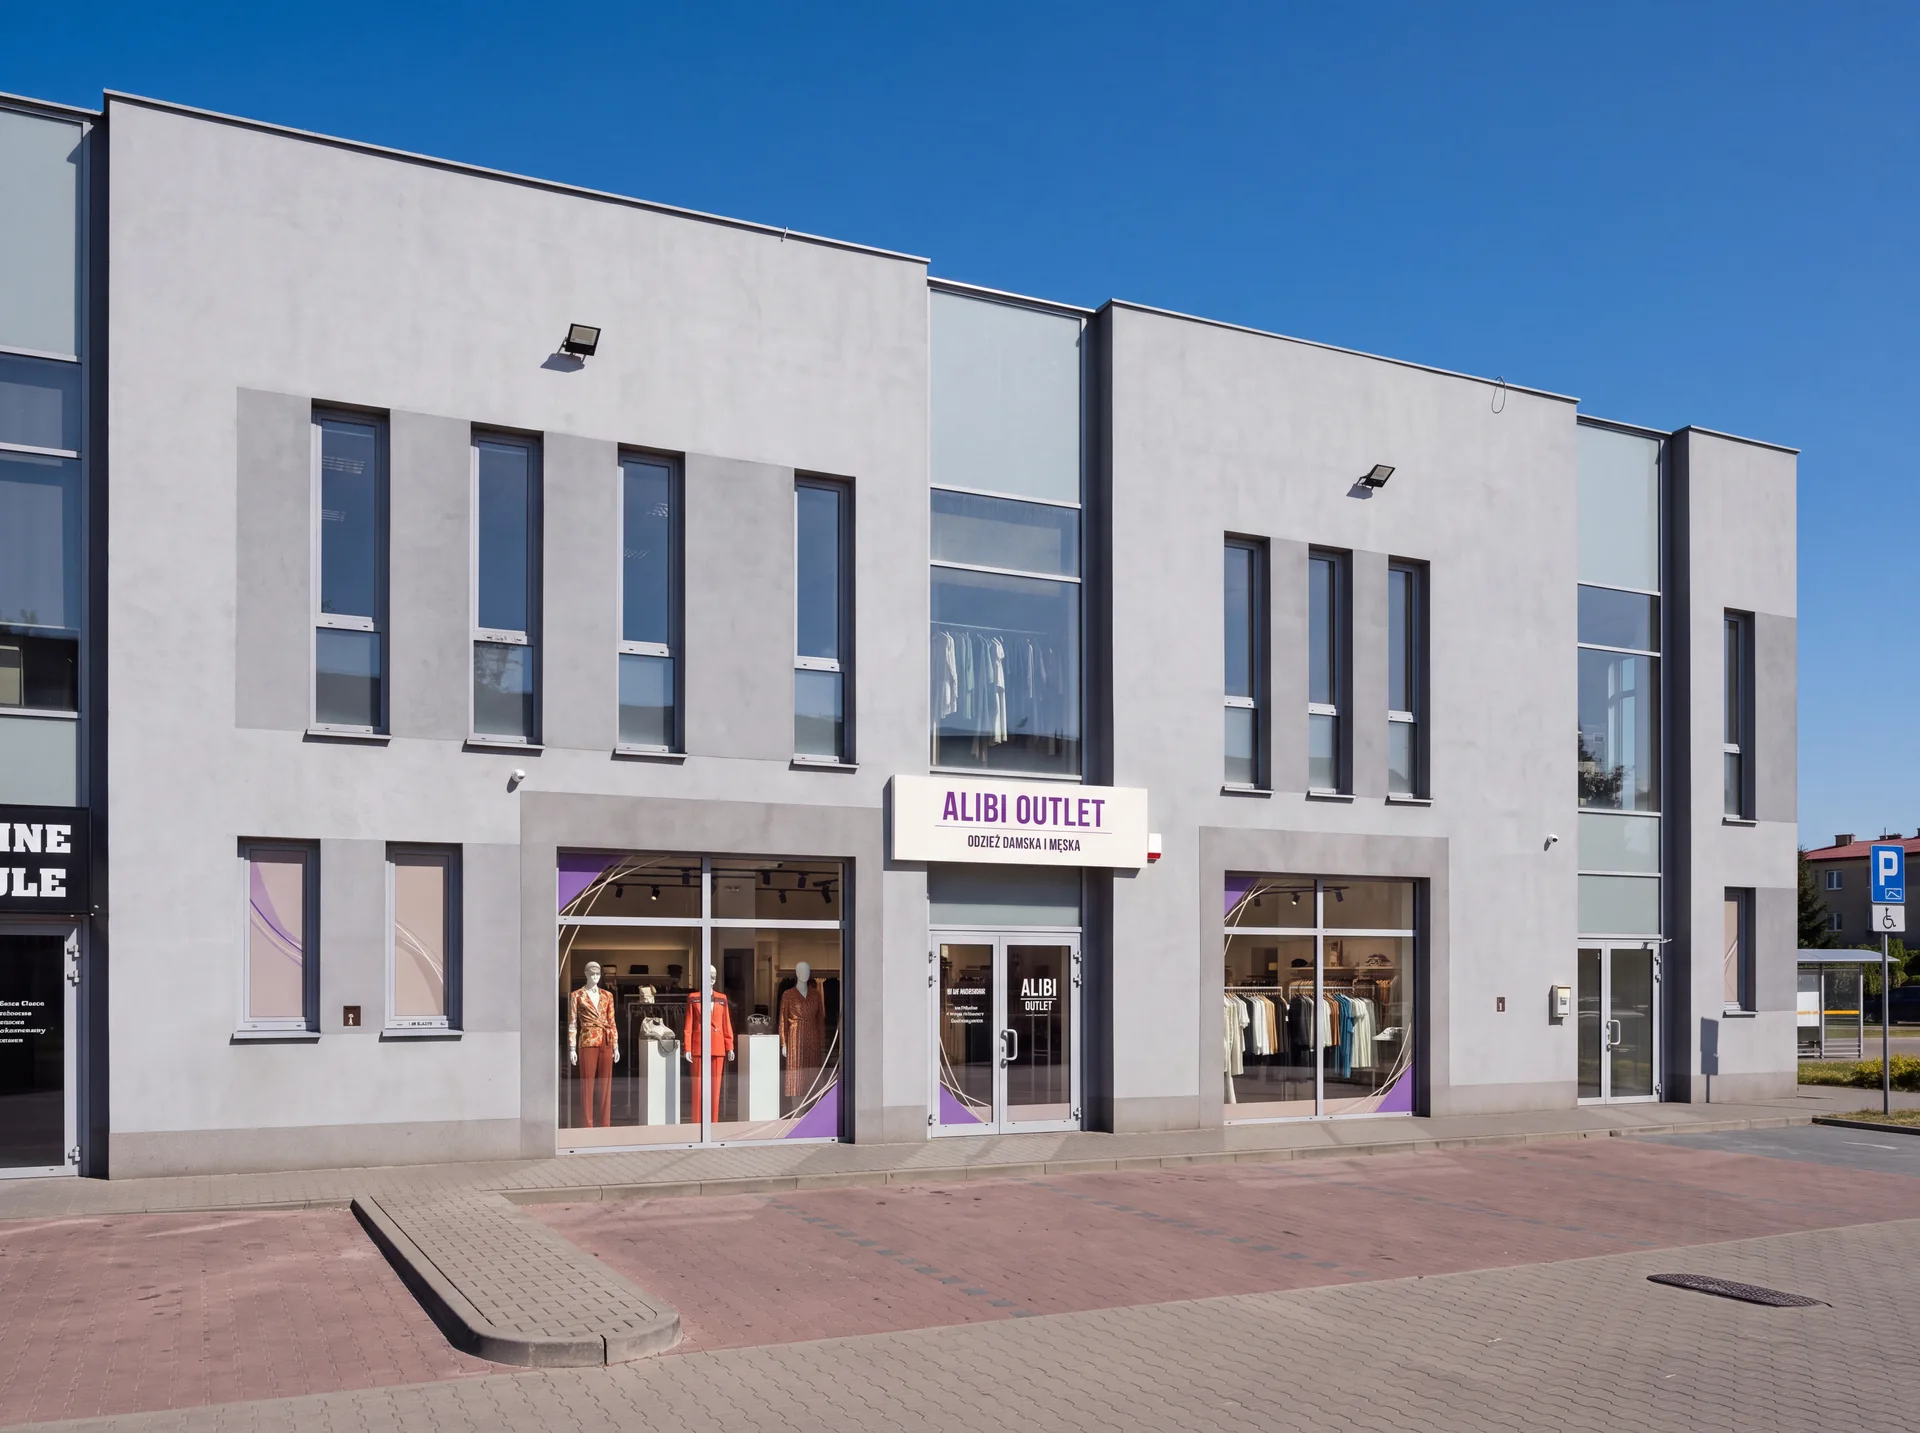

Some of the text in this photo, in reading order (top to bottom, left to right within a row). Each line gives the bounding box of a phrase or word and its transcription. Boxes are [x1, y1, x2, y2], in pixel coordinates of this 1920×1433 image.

[942, 791, 1105, 827] ALIBI OUTLET
[1002, 836, 1042, 851] DAMSKA
[1043, 838, 1047, 850] I
[1049, 839, 1081, 853] MĘSKA
[1879, 850, 1898, 886] P
[1021, 978, 1057, 996] ALIBI
[1025, 1000, 1053, 1011] OUTLET
